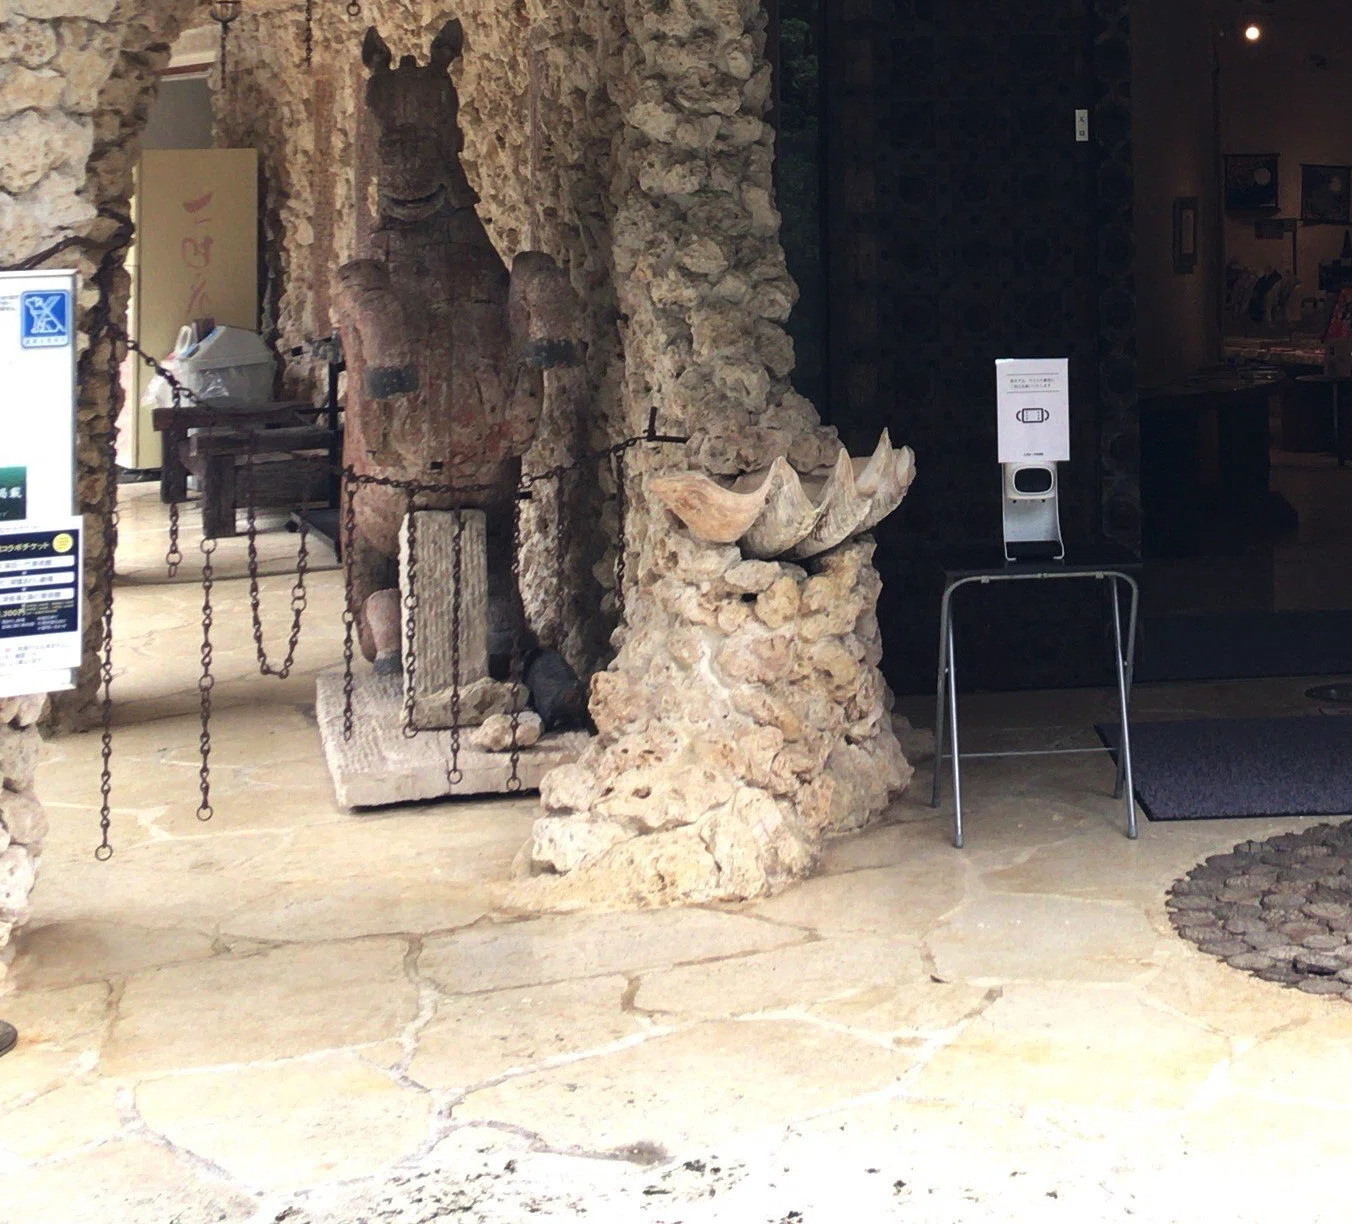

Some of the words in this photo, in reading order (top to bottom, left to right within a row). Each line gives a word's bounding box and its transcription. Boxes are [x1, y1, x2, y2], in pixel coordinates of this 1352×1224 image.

[0, 541, 49, 553] コラボチケット
